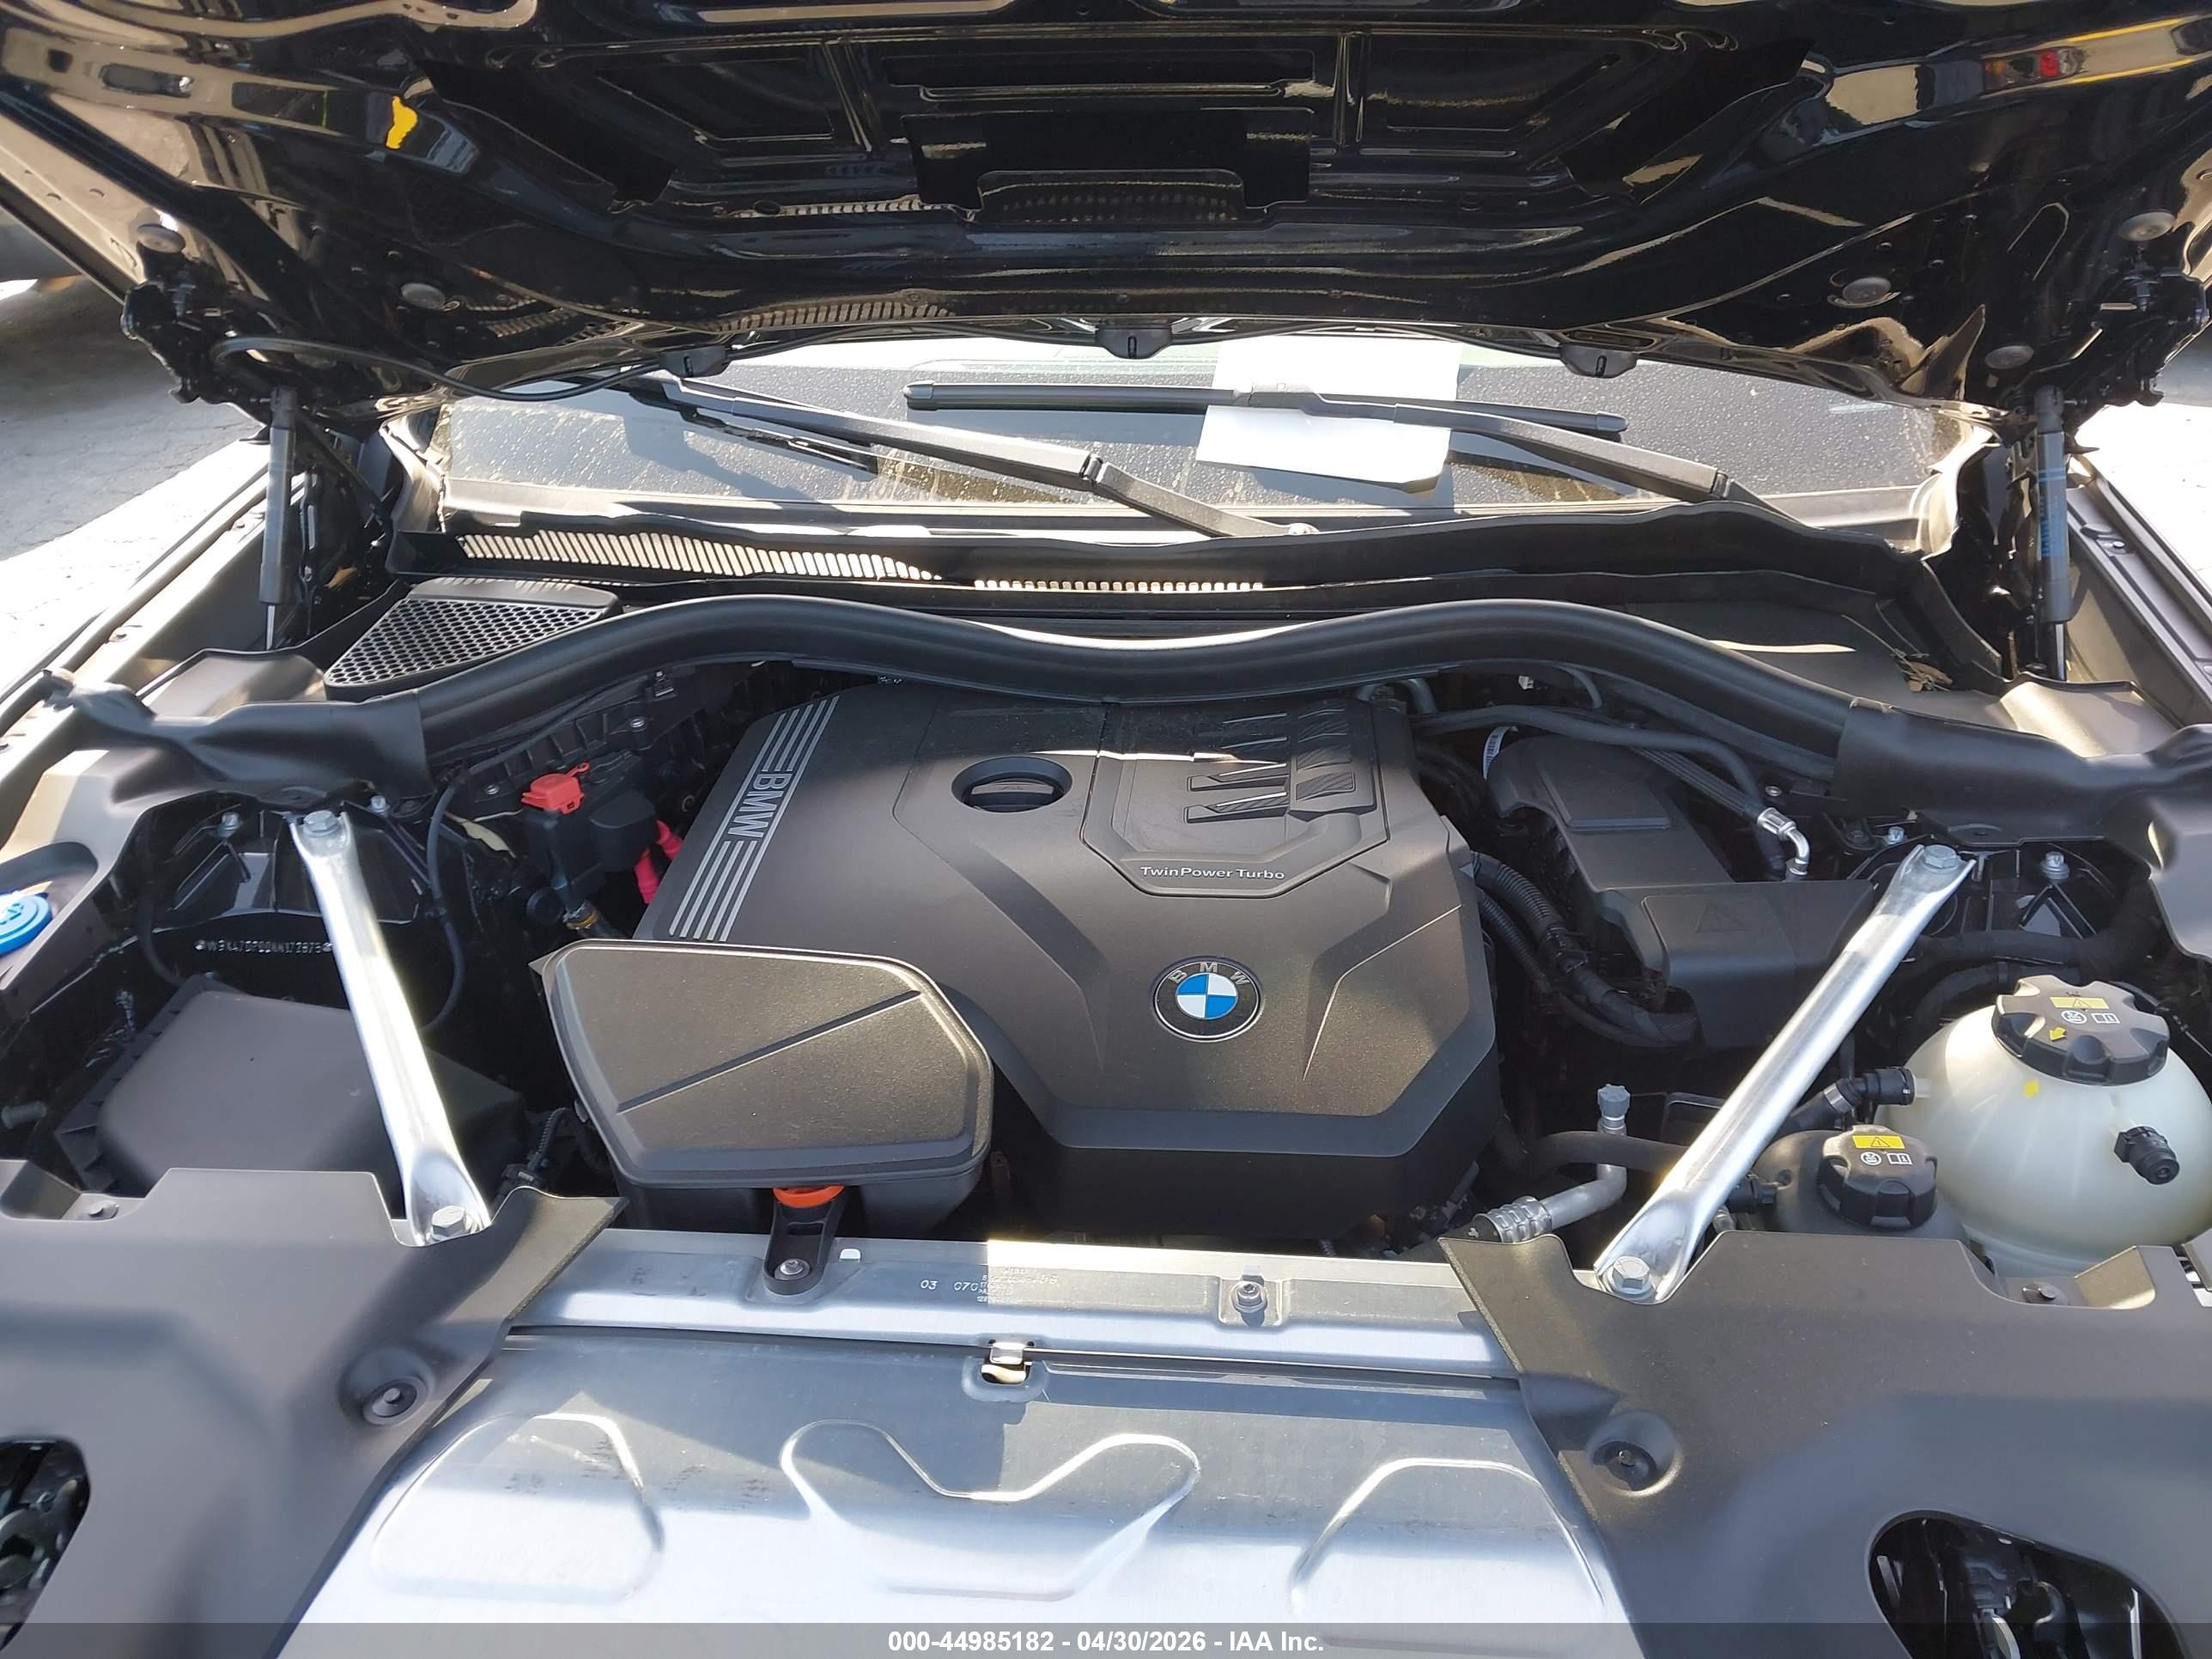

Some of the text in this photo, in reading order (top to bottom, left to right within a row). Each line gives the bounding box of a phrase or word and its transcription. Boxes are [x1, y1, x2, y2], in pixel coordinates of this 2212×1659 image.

[727, 772, 792, 838] BMW
[1236, 868, 1285, 880] Turbo
[1168, 961, 1250, 987] BMW
[920, 1279, 939, 1291] 03
